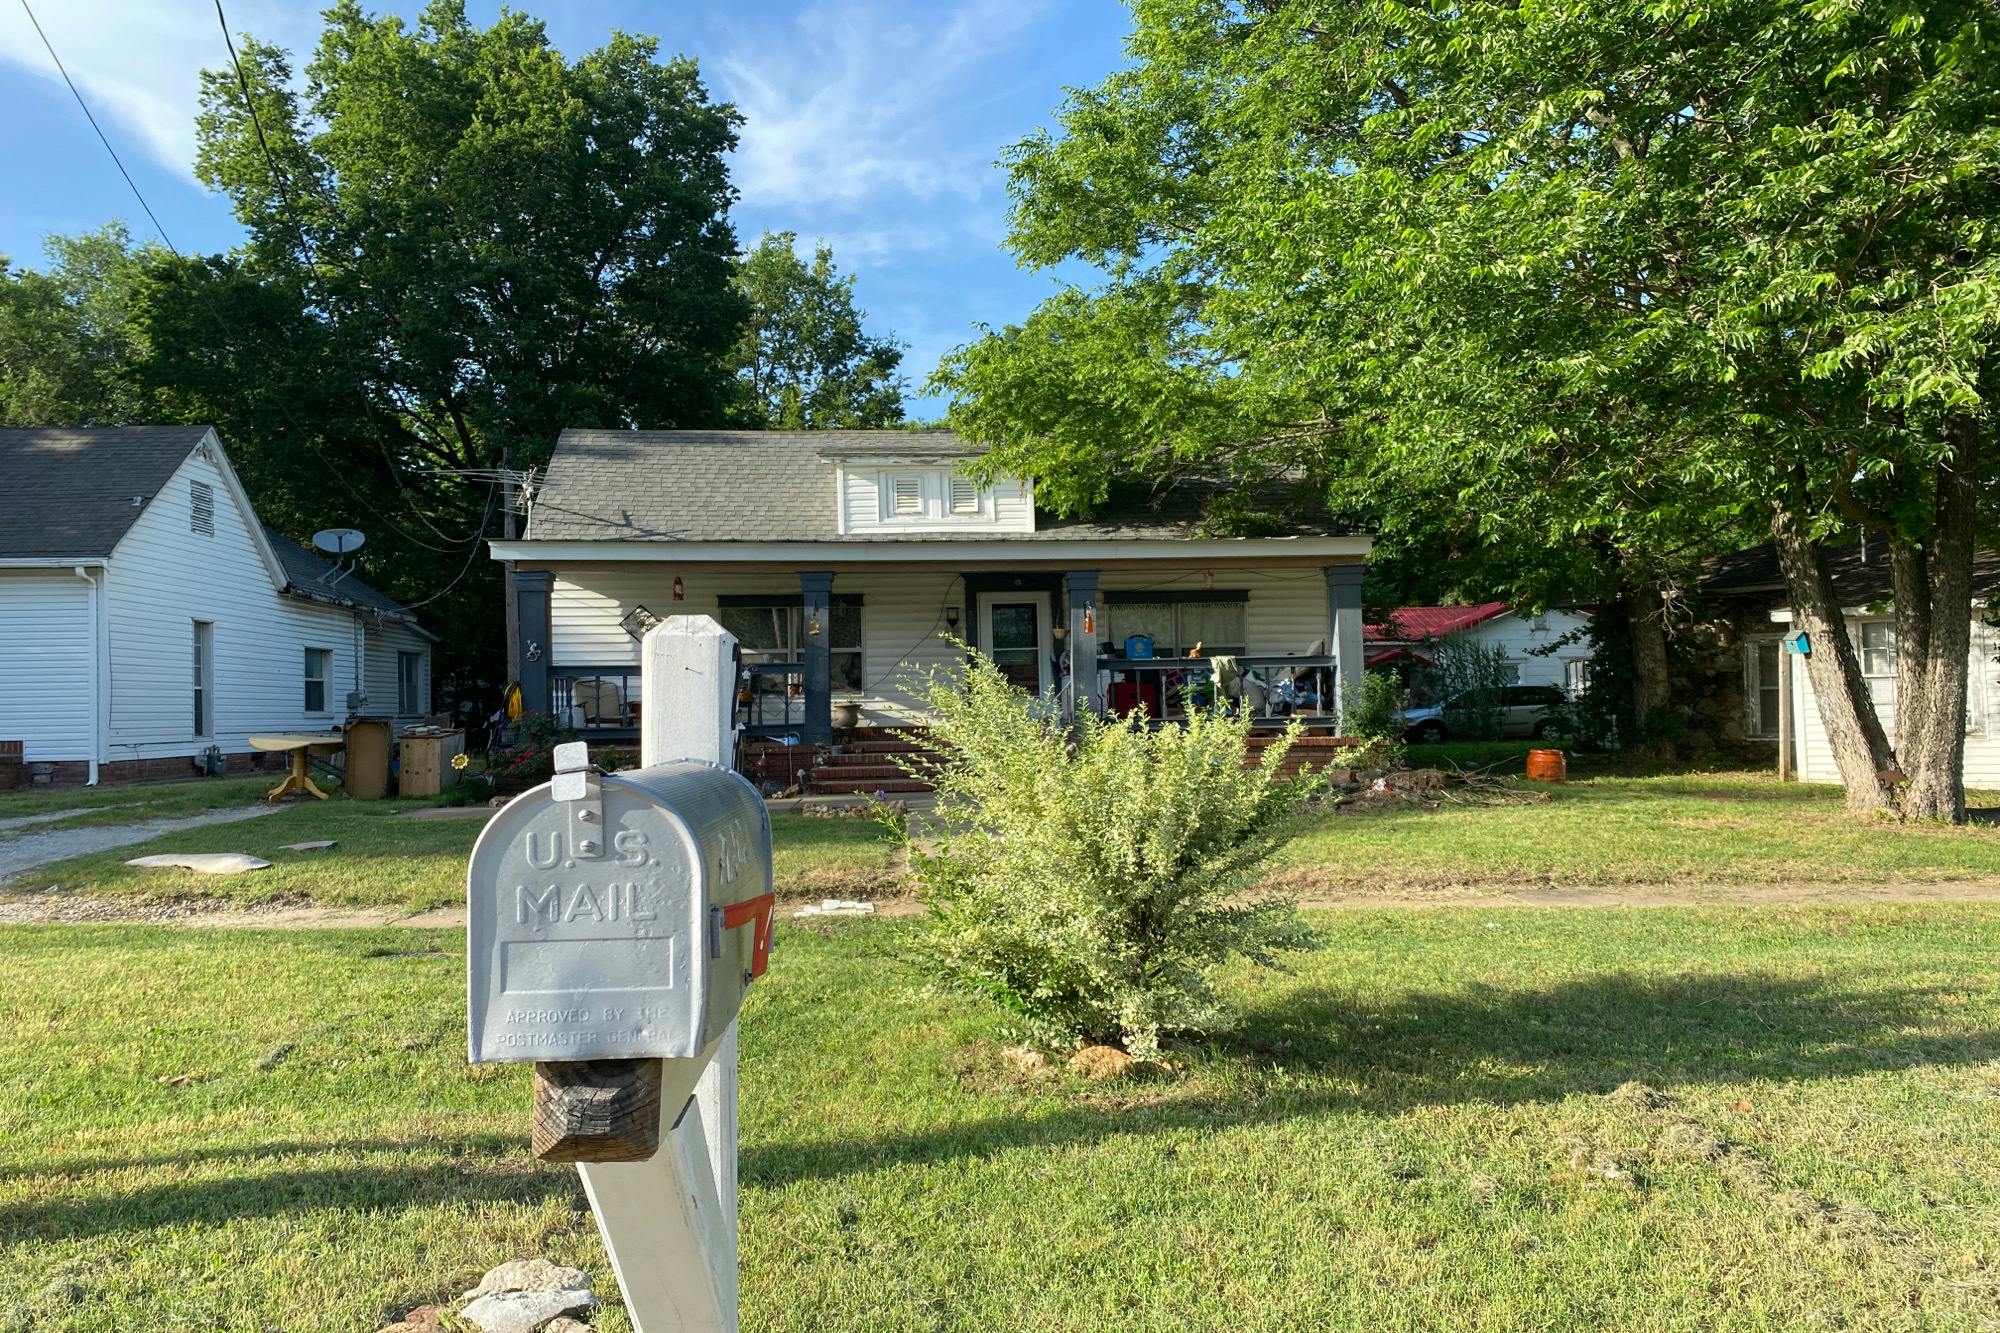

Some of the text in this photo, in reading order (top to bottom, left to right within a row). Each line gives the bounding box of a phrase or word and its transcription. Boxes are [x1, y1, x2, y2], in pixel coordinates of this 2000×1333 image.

[516, 881, 657, 924] MAIL
[505, 1006, 669, 1025] APPROVED BY THE
[496, 1031, 599, 1047] POSTMASTER
